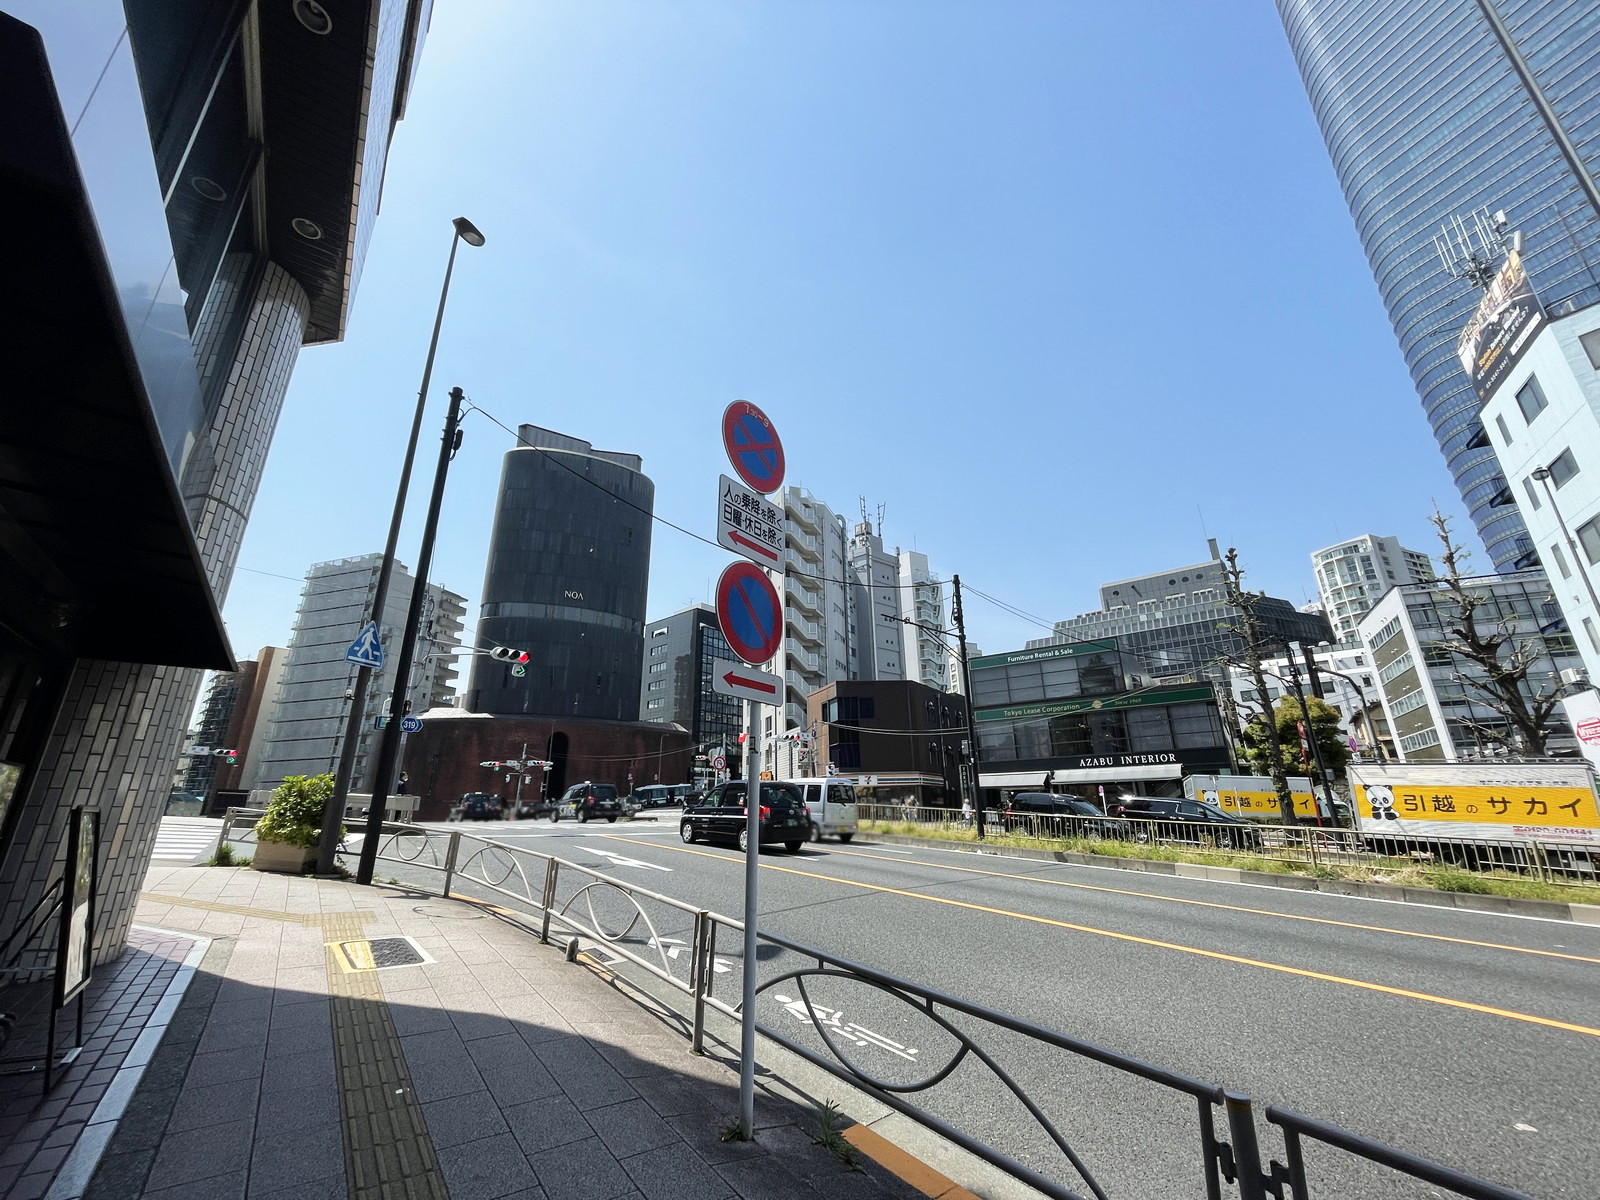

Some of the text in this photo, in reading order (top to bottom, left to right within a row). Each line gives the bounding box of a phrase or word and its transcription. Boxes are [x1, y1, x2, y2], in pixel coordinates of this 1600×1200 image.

[723, 484, 783, 530] 人の乗降を除く
[1007, 653, 1034, 663] Furniture
[1034, 650, 1054, 660] Rental
[1060, 647, 1074, 655] Sale
[1003, 703, 1080, 718] Tokyo Lease Corporation
[403, 720, 416, 729] 319
[1079, 752, 1177, 767] AZABU INTERIOR
[1224, 795, 1310, 810] 引越のサイ
[1402, 793, 1582, 818] 引越のサカイ
